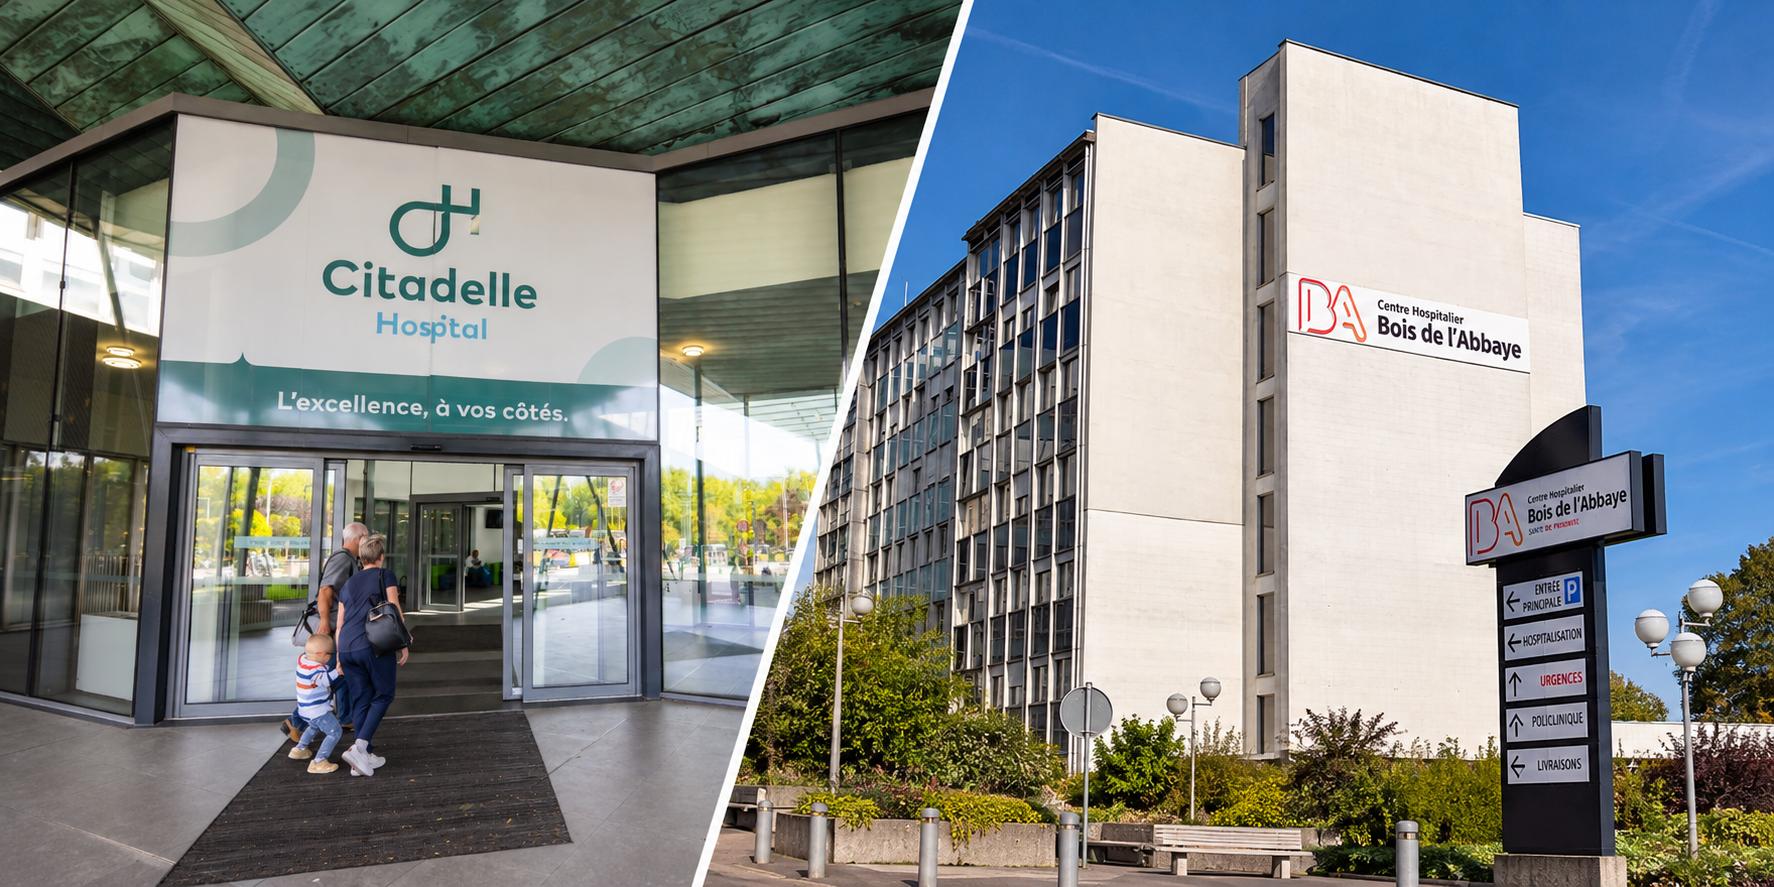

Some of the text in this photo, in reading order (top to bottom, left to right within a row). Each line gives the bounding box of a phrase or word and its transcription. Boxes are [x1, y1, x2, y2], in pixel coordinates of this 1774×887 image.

[322, 259, 538, 310] Citadelle
[1377, 299, 1465, 325] Centre Hospitalier
[1377, 315, 1522, 361] Bois de l'Abbaye
[277, 391, 569, 422] L'excellence, à vos côtés.
[1527, 483, 1585, 504] Centre Hospitalier
[1527, 504, 1553, 524] Bois
[1555, 499, 1571, 518] de
[1573, 489, 1627, 514] l'Abbaye
[1534, 580, 1561, 596] ENTRÉE
[1522, 596, 1562, 613] PRINCIPALE
[1523, 627, 1582, 647] HOSPITALISATION
[1540, 671, 1583, 687] URGENCES
[1531, 711, 1584, 728] POLICLINIQUE
[1537, 757, 1582, 772] LIVRAISONS
